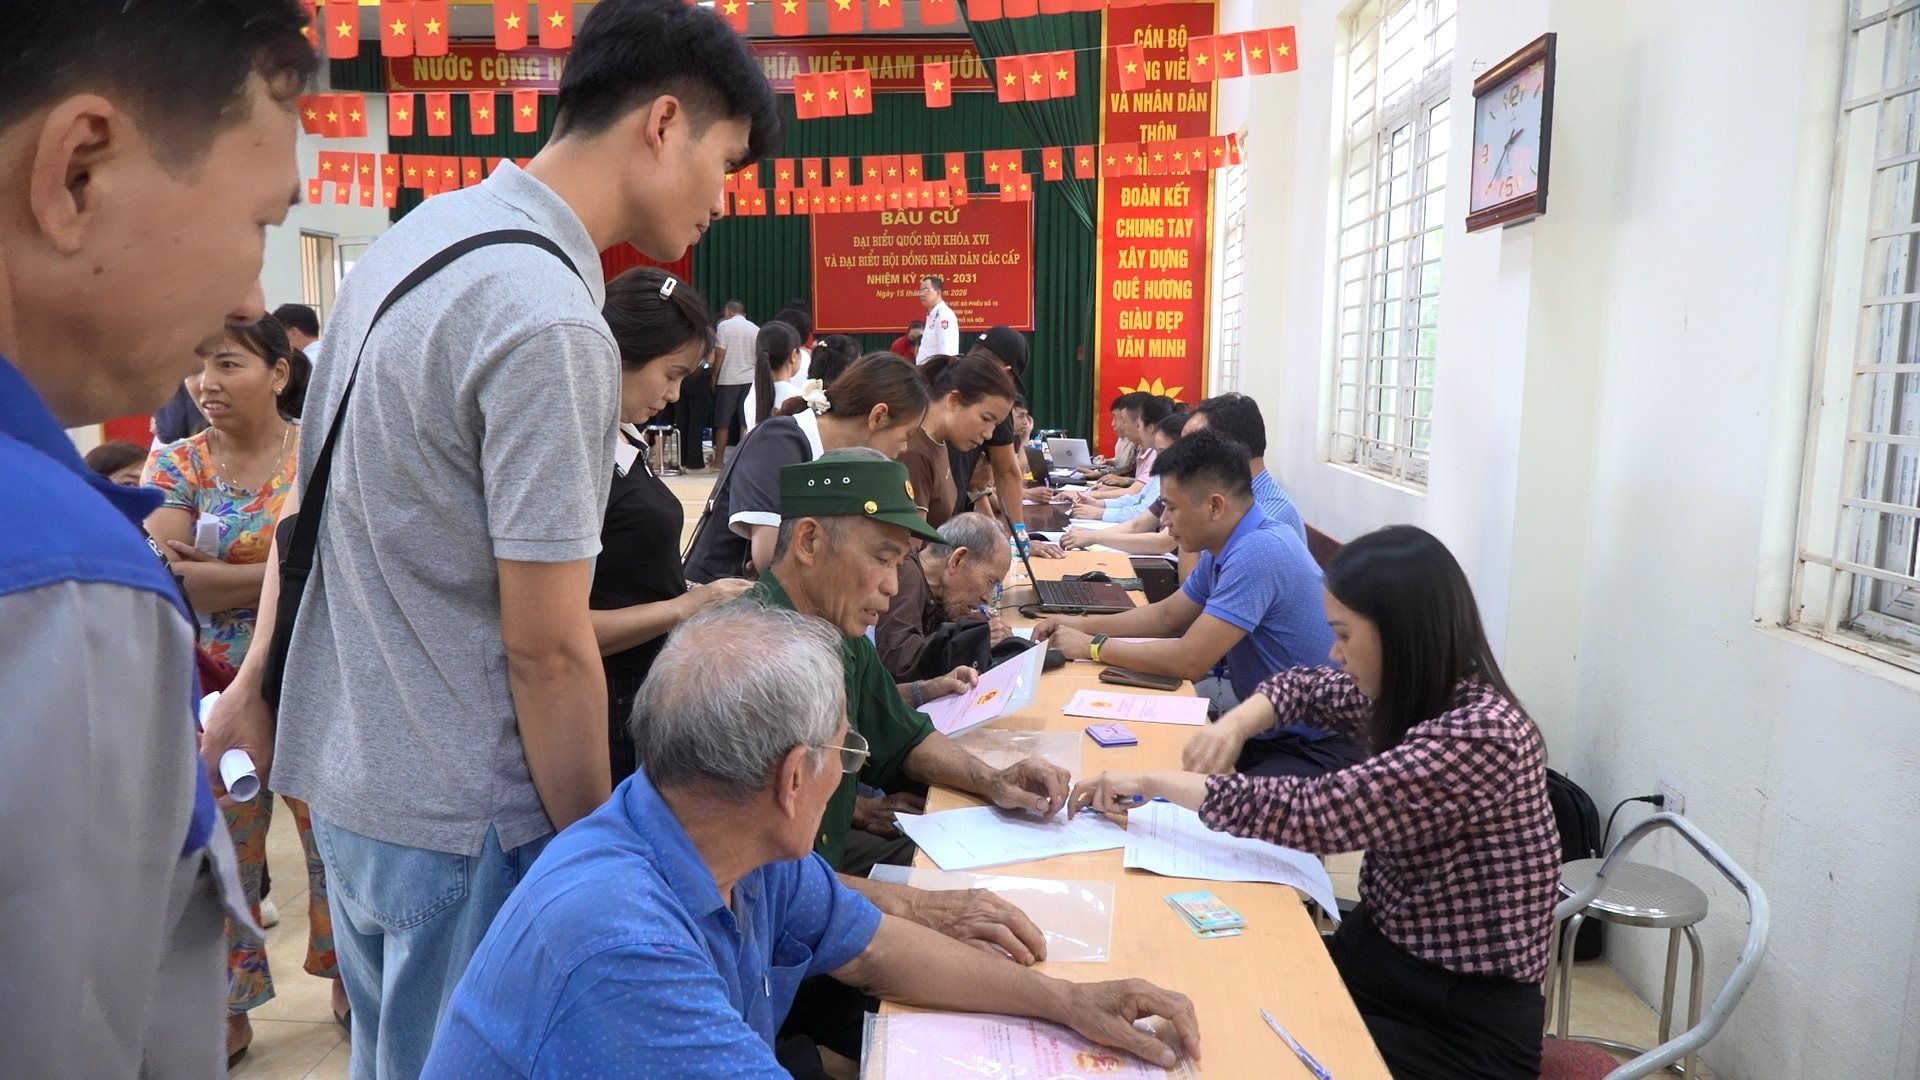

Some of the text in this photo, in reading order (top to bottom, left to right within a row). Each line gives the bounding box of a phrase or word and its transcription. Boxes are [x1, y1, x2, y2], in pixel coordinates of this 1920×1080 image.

[1134, 24, 1188, 52] CÁN BỘ
[413, 52, 473, 81] NƯỚC
[480, 52, 541, 86] CỘNG
[548, 51, 569, 80] H
[863, 55, 914, 79] NAM
[1111, 88, 1207, 112] VÀ NHÂN DÂN
[1139, 120, 1177, 144] THÔN
[1121, 181, 1190, 207] ĐOÀN KẾT
[929, 205, 960, 225] CỬ
[853, 229, 989, 249] ĐẠI BIỂU QUỐC HỘI KHÓA XVI
[1116, 218, 1193, 238] CHUNG TAY
[824, 248, 1020, 269] VÀ ĐẠI BIỂU HỘI ĐỒNG NHÂN DÂN CÁC CẤP
[1118, 246, 1188, 272] XÂY DỰNG
[867, 272, 900, 287] NHIỆM
[902, 271, 917, 284] KỲ
[952, 273, 977, 283] 2031
[1112, 276, 1192, 301] QUÊ HƯƠNG
[876, 290, 895, 300] Ngày
[950, 289, 967, 297] 2026
[1119, 306, 1184, 333] GIÀU ĐẸP
[1116, 335, 1187, 357] VĂN MINH
